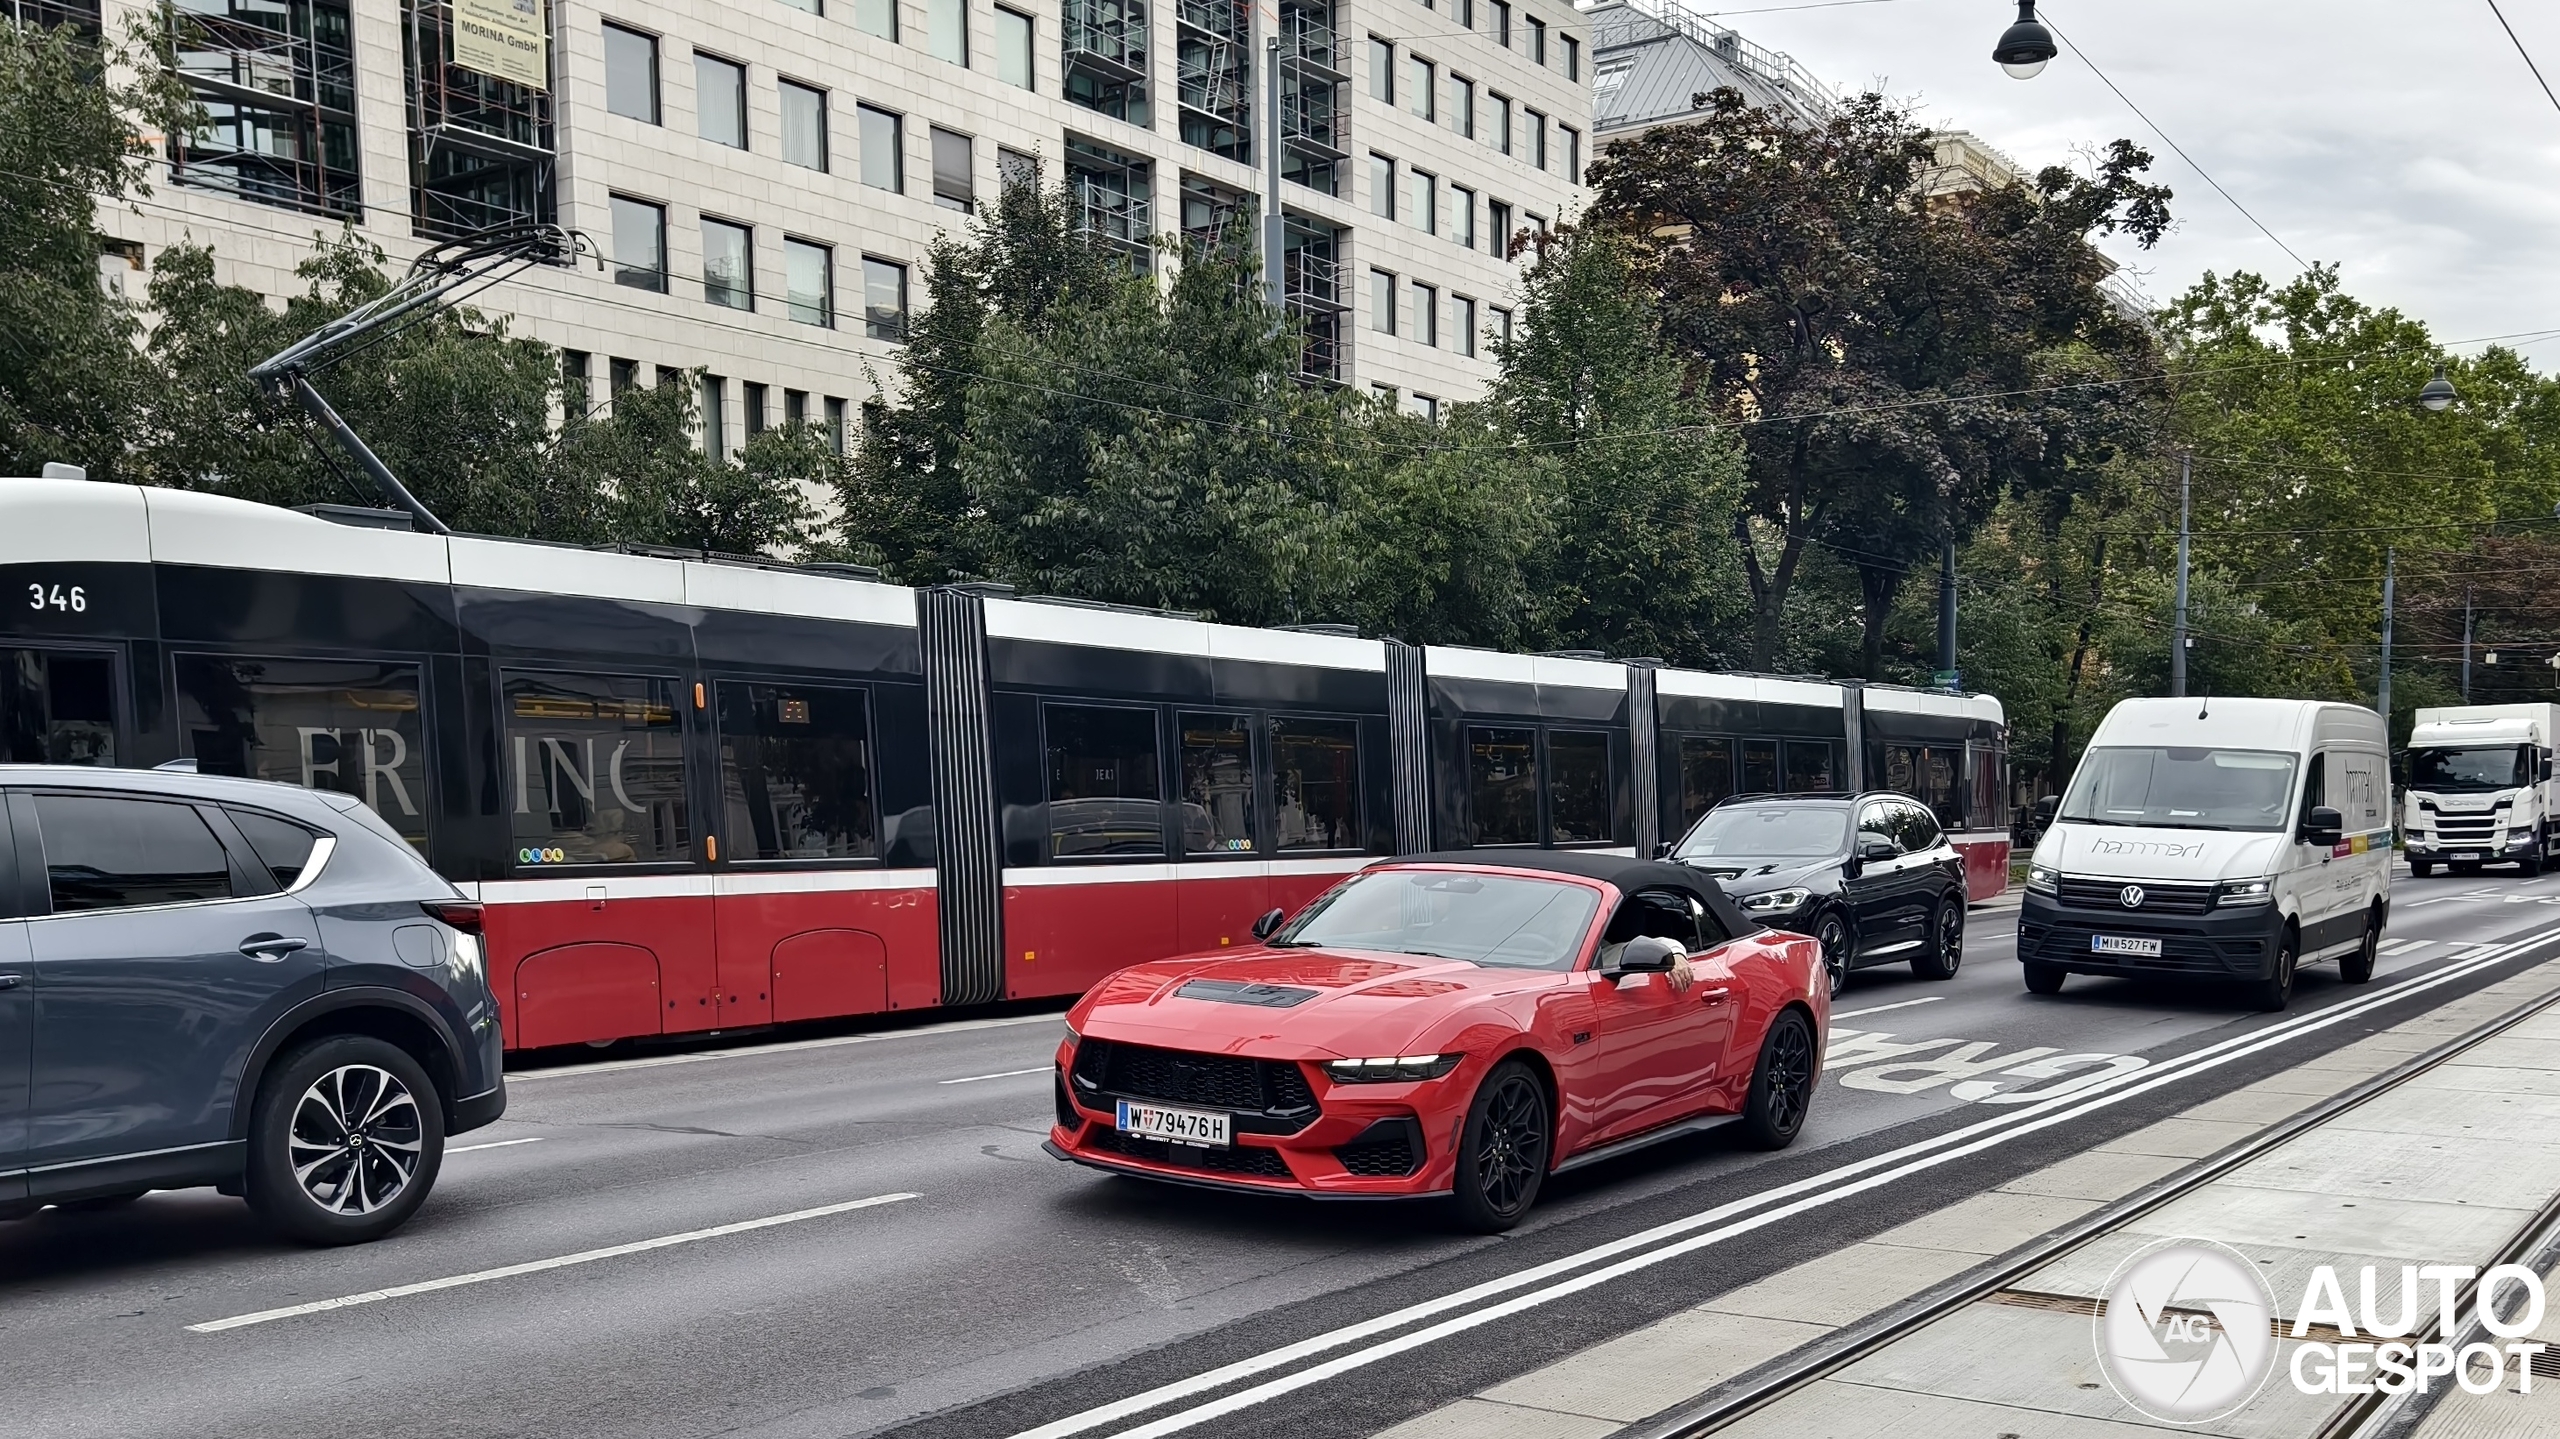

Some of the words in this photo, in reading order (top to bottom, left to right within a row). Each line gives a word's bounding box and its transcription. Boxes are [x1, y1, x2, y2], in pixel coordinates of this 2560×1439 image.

[461, 20, 505, 44] MORINA
[507, 35, 538, 54] GmbH
[29, 583, 86, 612] 346
[2444, 799, 2486, 807] SCANIA
[2121, 939, 2141, 951] 527
[2142, 940, 2157, 952] FW
[1130, 1107, 1142, 1128] W
